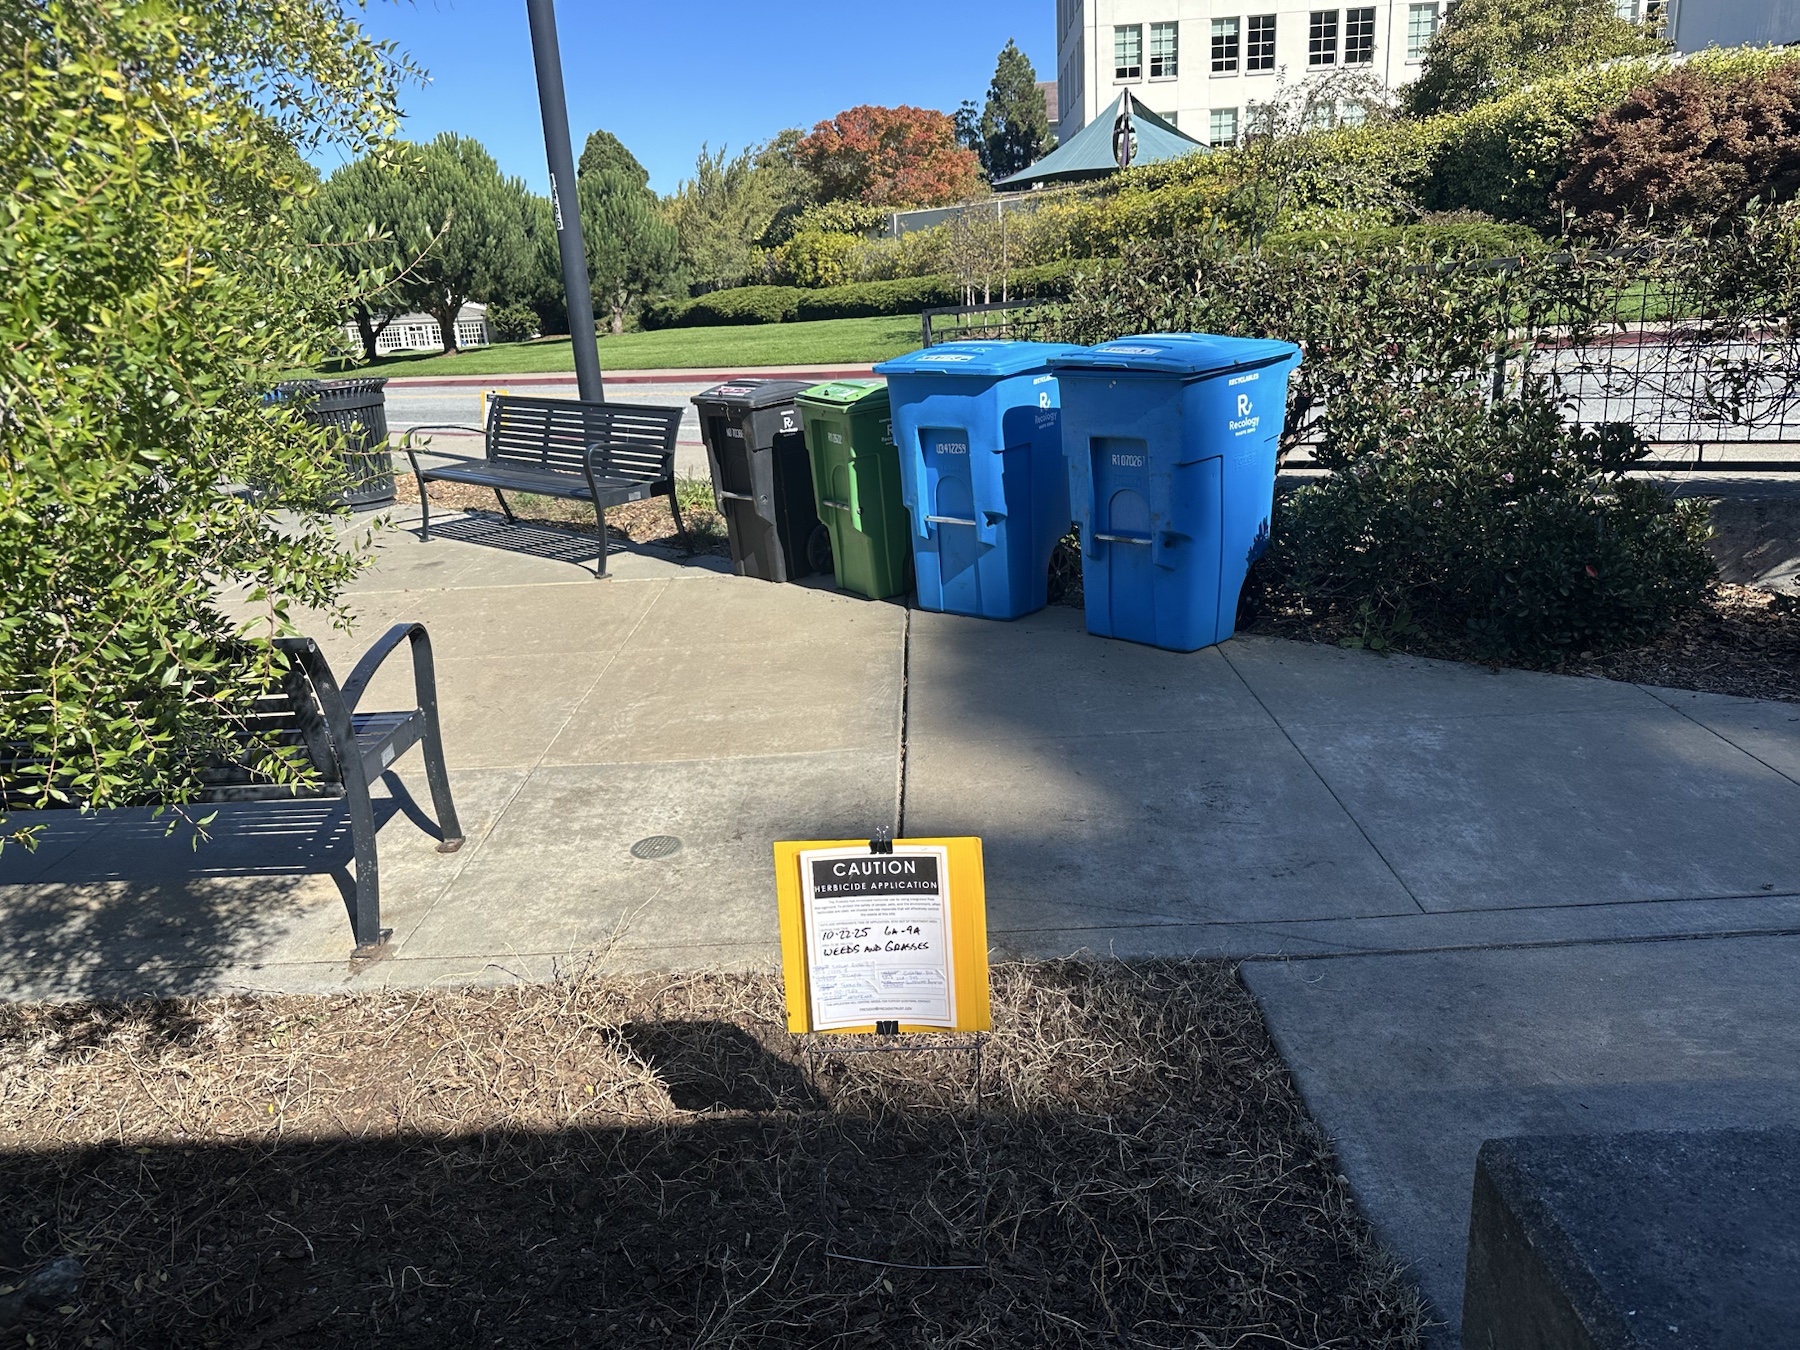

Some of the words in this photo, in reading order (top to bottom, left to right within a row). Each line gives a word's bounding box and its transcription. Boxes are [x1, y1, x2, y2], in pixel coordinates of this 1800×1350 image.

[1228, 372, 1259, 387] RECYCLABLES
[1228, 416, 1260, 431] Recology
[833, 860, 916, 876] CAUTION
[814, 882, 866, 893] HERBICIDE
[870, 881, 938, 890] APPLICATION
[824, 944, 860, 956] WEEDS
[884, 940, 929, 952] GRASSES
